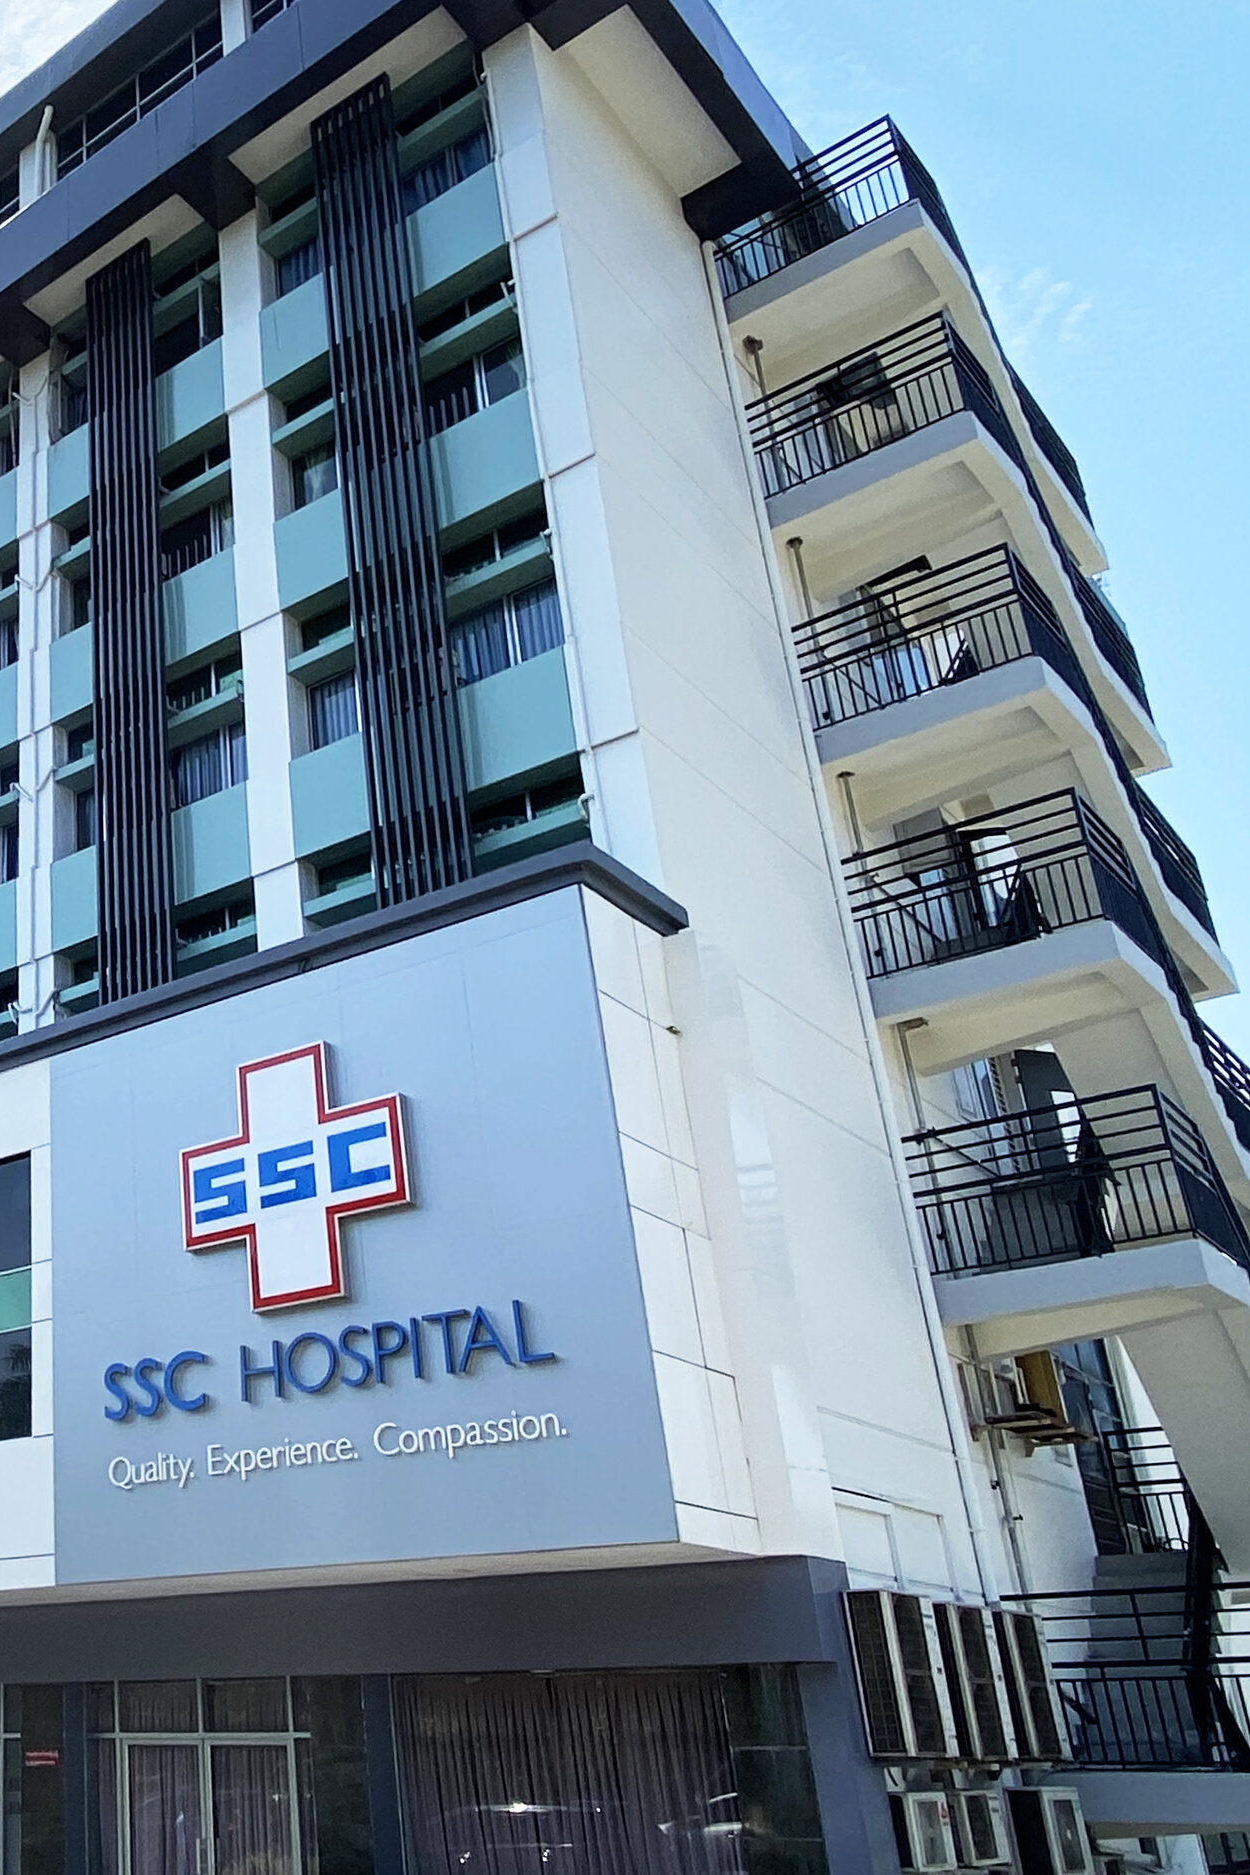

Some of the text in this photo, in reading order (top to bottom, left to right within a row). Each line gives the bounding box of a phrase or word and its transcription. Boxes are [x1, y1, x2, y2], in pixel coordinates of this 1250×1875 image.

[193, 1121, 391, 1225] SSC
[103, 1299, 557, 1422] SSC HOSPITAL
[108, 1410, 568, 1490] Quality. Experience. Compassion.
